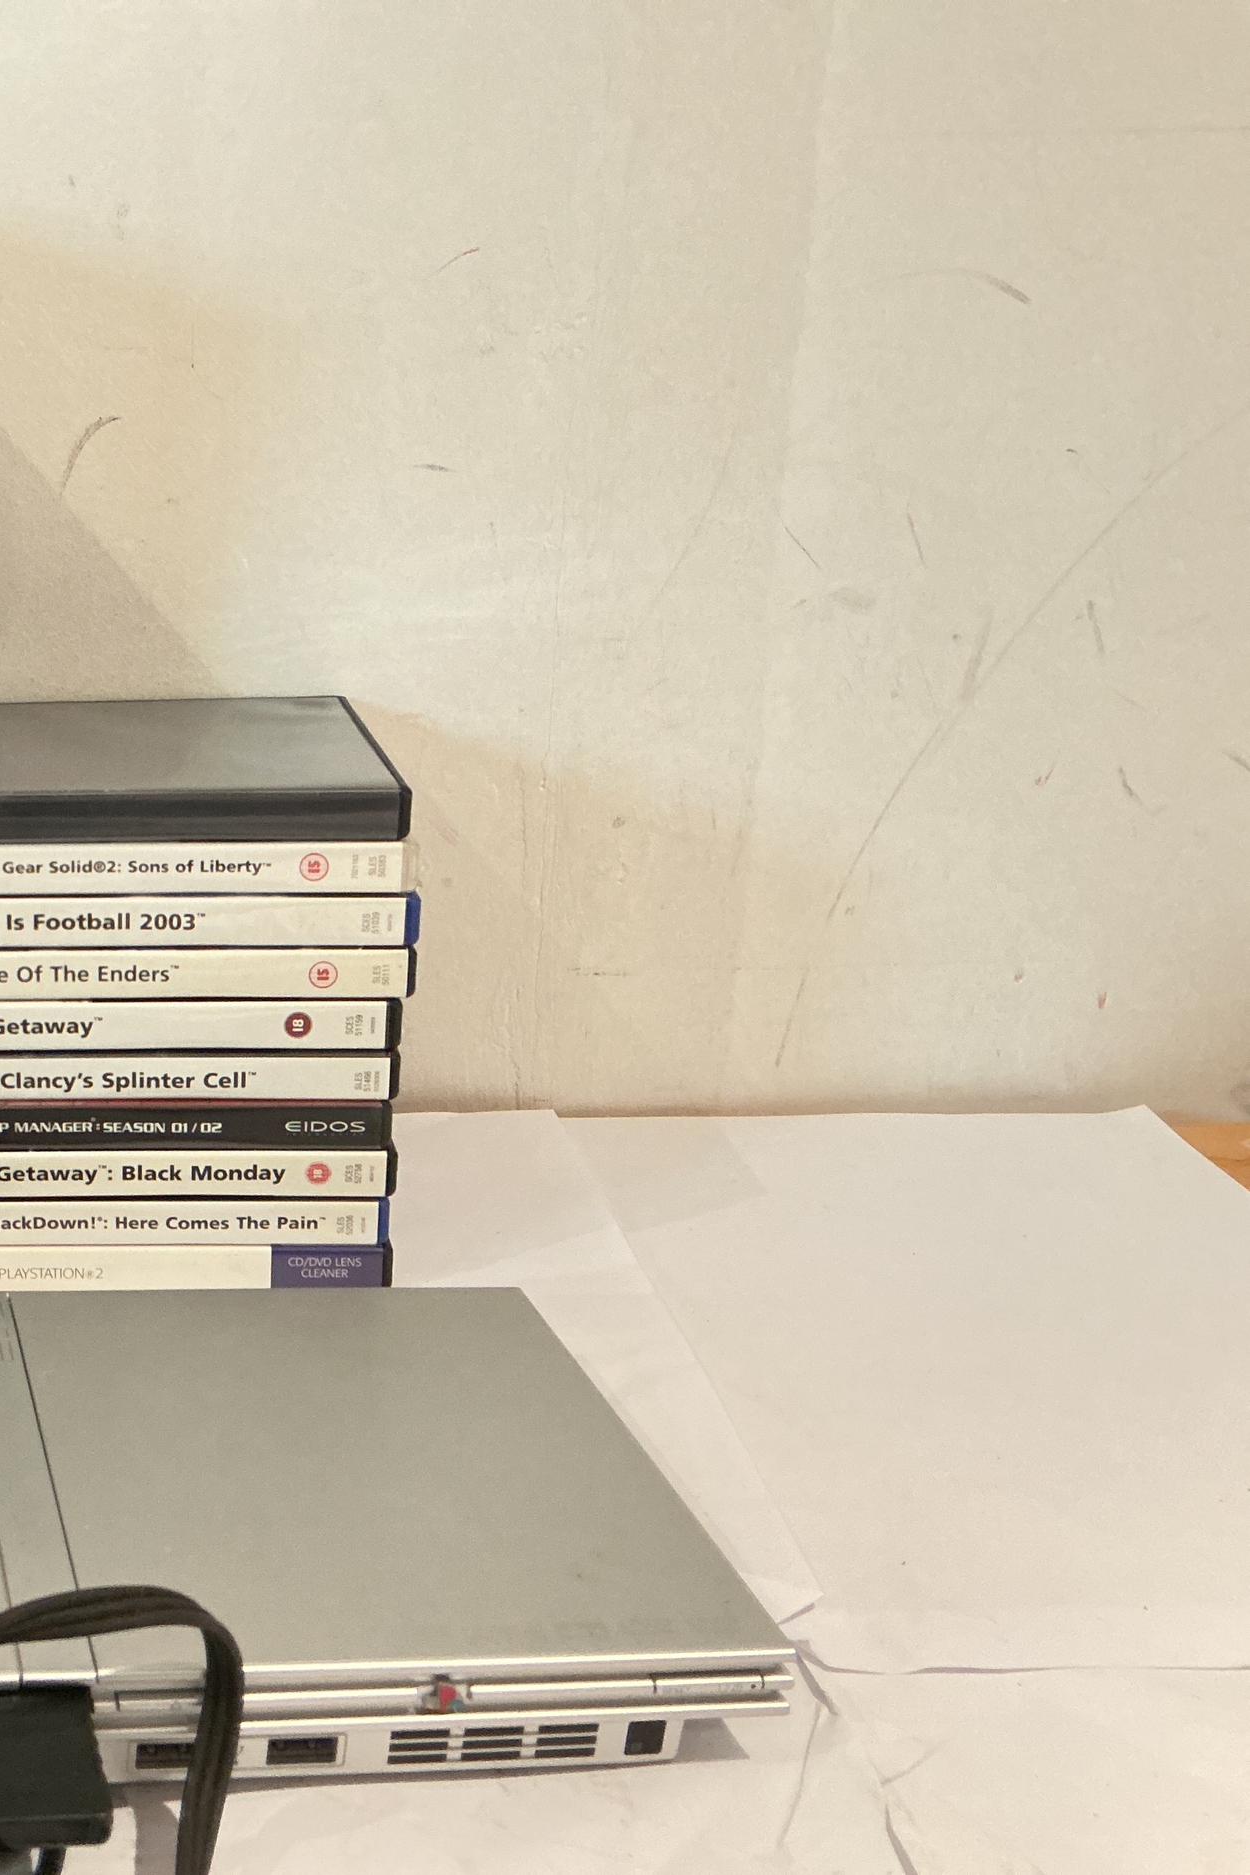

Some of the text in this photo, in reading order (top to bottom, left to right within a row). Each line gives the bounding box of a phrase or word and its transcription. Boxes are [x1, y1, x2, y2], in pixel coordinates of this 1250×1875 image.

[3, 862, 42, 874] Gear
[129, 861, 168, 873] Sons
[176, 860, 193, 872] of
[308, 861, 320, 873] 15
[7, 915, 24, 930] Is
[34, 913, 130, 930] Football
[17, 965, 42, 982] Of
[50, 965, 89, 982] The
[317, 969, 329, 980] 15
[293, 1019, 304, 1031] 18
[102, 1072, 195, 1092] Splinter
[103, 1123, 165, 1132] SEASON
[285, 1121, 365, 1132] EIDOS
[122, 1165, 181, 1181] Black
[192, 1164, 285, 1184] Monday
[116, 1217, 158, 1229] Here
[166, 1217, 229, 1229] Comes
[237, 1216, 269, 1229] The
[288, 1257, 361, 1267] CD/DVD LENS
[301, 1269, 348, 1277] CLEANER
